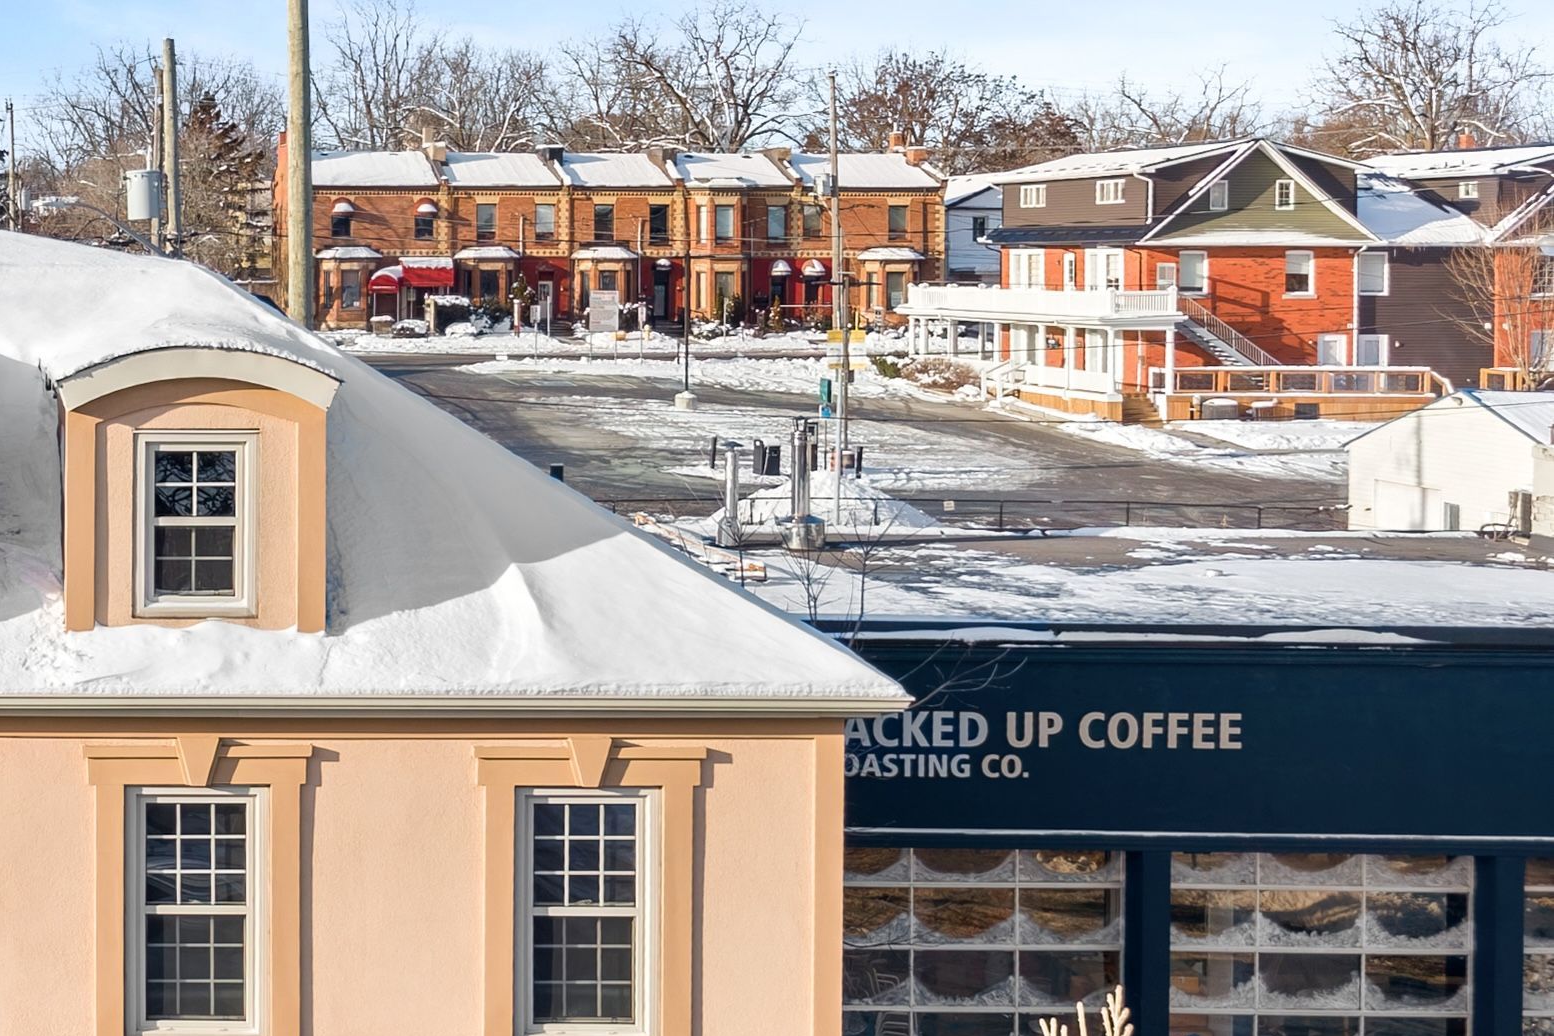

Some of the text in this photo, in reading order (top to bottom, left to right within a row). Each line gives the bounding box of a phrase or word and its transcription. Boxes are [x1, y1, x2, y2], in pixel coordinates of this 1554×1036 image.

[1006, 711, 1063, 748] UP
[1078, 711, 1243, 749] COFFEE
[844, 752, 1030, 779] OASTING CO.
